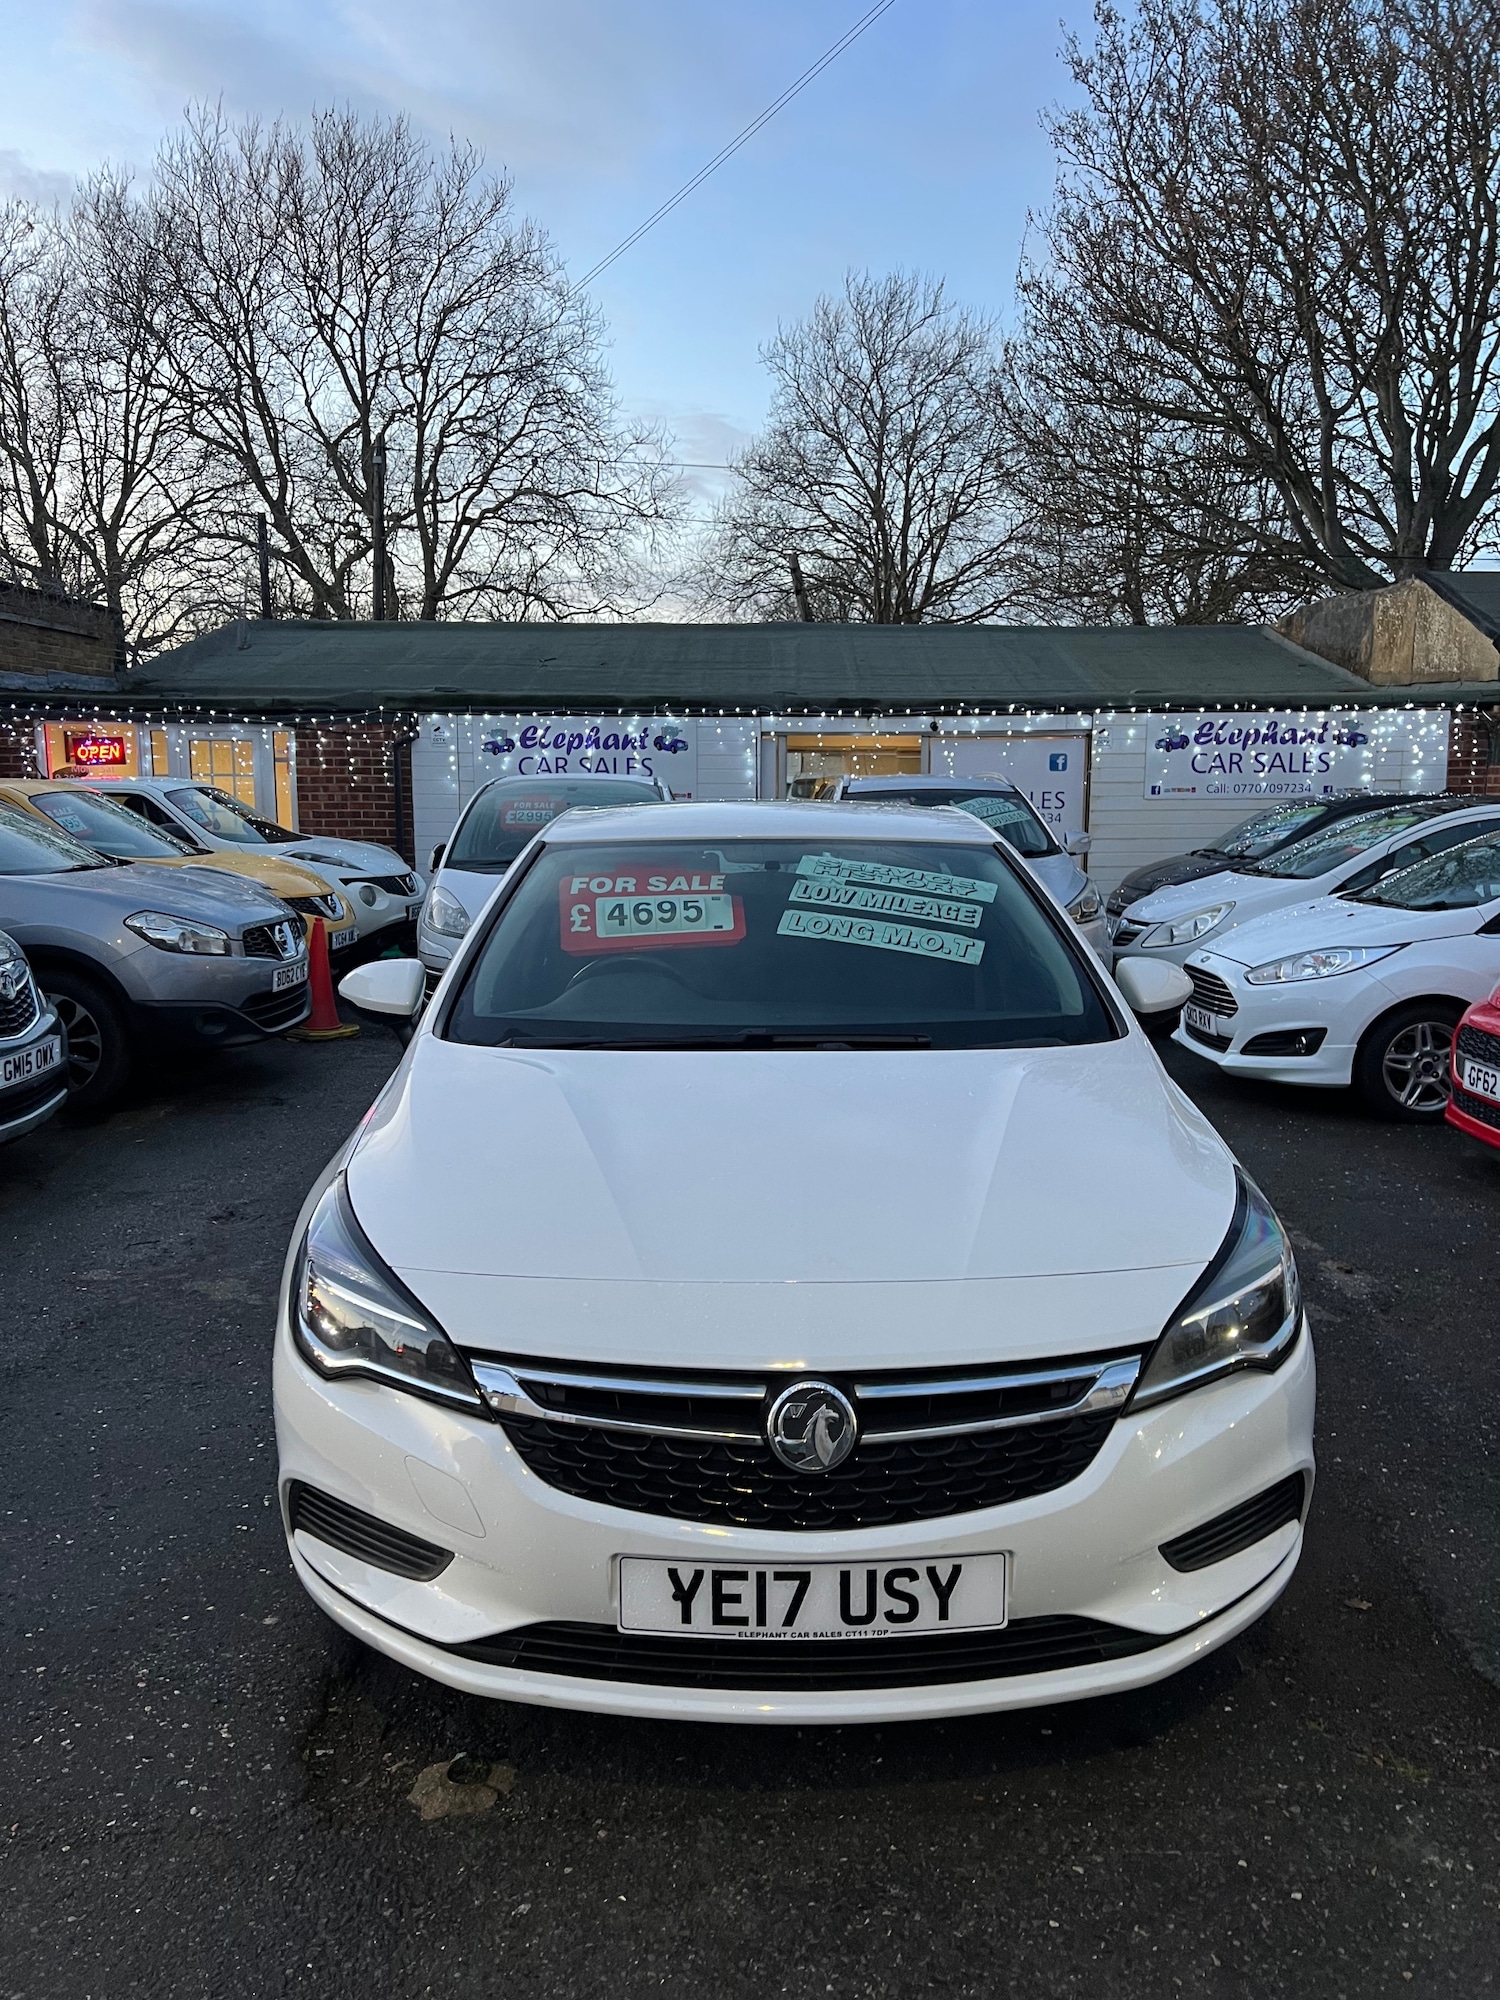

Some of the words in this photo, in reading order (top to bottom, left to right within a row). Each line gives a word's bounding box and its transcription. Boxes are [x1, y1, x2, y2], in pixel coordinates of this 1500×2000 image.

[519, 725, 649, 756] Elephant
[1193, 721, 1328, 751] Elephant
[77, 745, 119, 759] OPEN
[1191, 752, 1242, 774] CAR
[1253, 752, 1330, 774] SALES
[518, 757, 568, 775] CAR
[579, 757, 653, 777] SALES
[1030, 792, 1065, 809] LES
[1206, 783, 1229, 794] Call:
[517, 812, 552, 822] 2995
[570, 877, 637, 895] FOR
[647, 875, 726, 891] SALE
[816, 858, 977, 888] SERVICE
[607, 900, 703, 927] 4695
[796, 881, 858, 903] LOW
[860, 889, 981, 924] MILEAGE
[788, 914, 875, 941] LONG
[881, 926, 976, 958] M.O.T
[277, 967, 294, 987] BD62
[4, 1052, 32, 1081] GM15
[36, 1042, 54, 1069] OWX
[1468, 1066, 1497, 1095] GF62
[668, 1567, 811, 1627] YE17
[839, 1564, 962, 1626] USY
[845, 1630, 868, 1638] CT11
